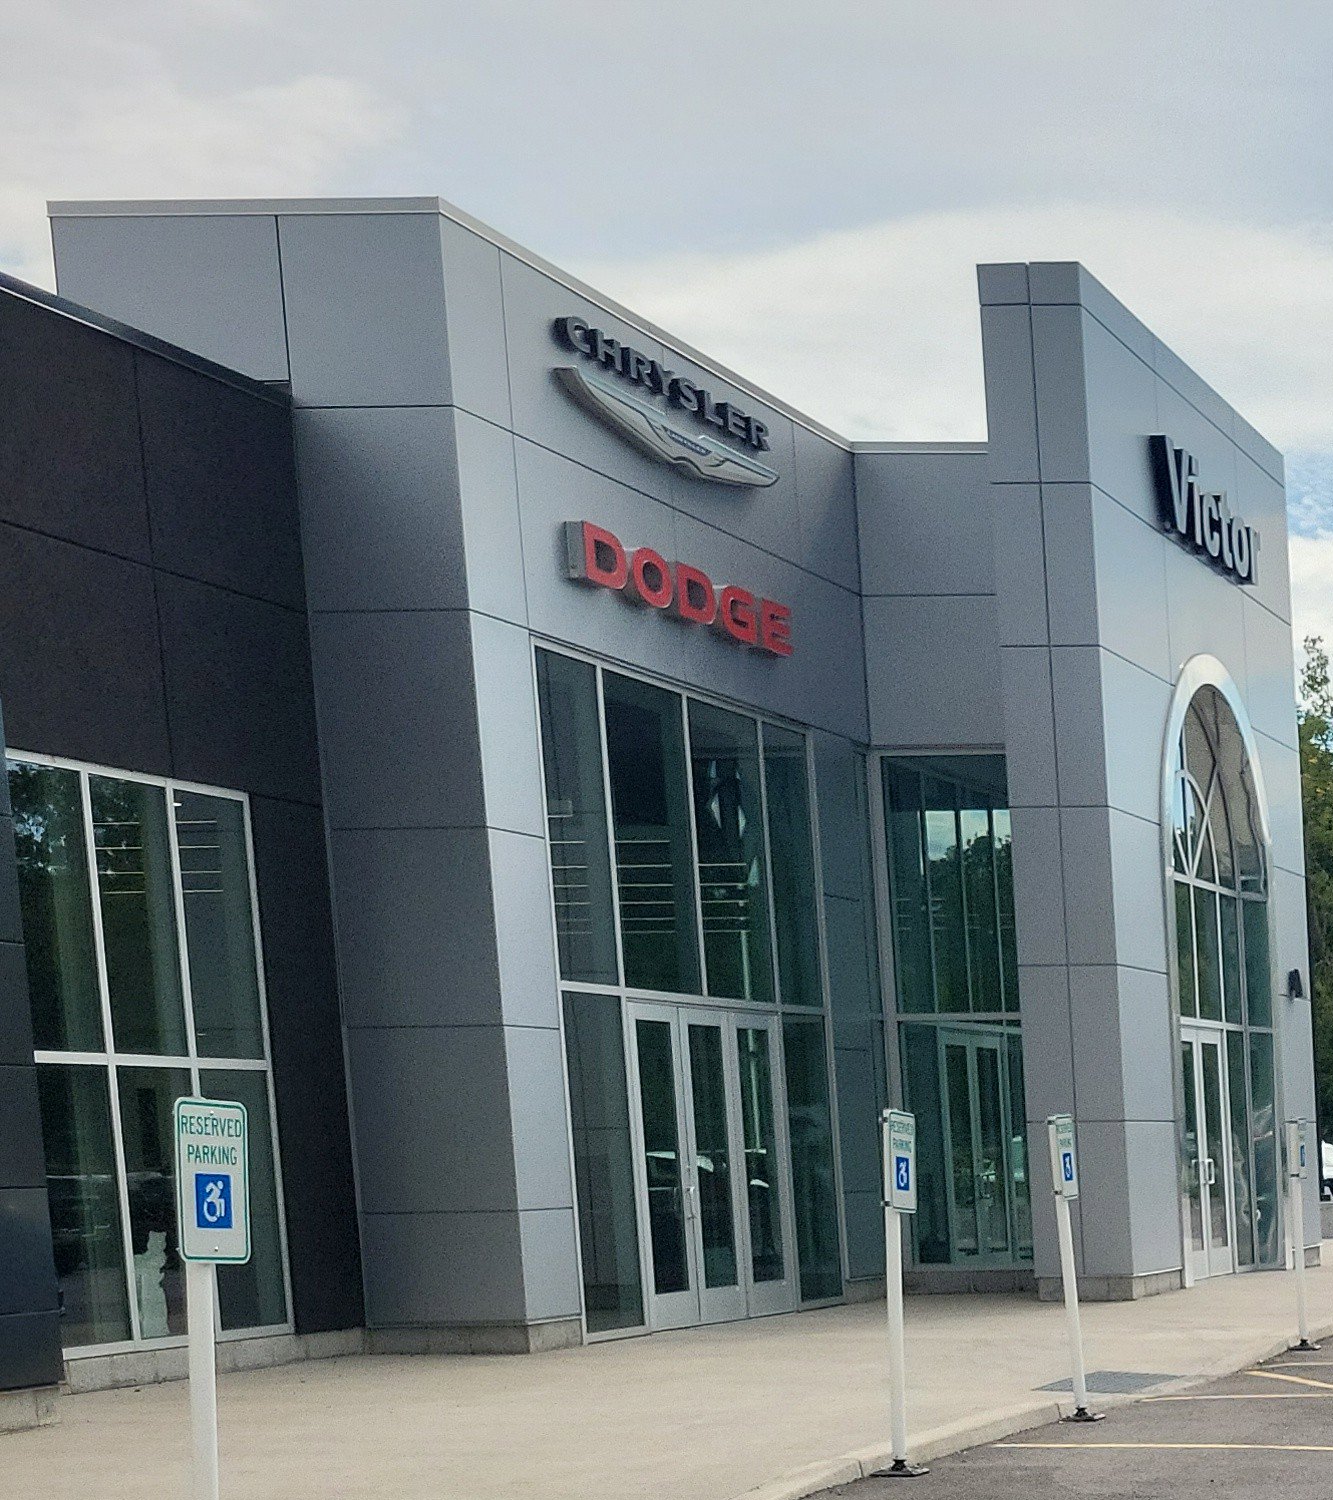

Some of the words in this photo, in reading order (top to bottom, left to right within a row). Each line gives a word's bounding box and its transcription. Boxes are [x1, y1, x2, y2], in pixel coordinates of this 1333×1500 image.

[557, 316, 770, 451] CHRYSLER
[1160, 435, 1260, 585] Victor
[581, 520, 794, 657] DODGE
[180, 1114, 243, 1138] RESERVED
[186, 1143, 238, 1166] PARKING
